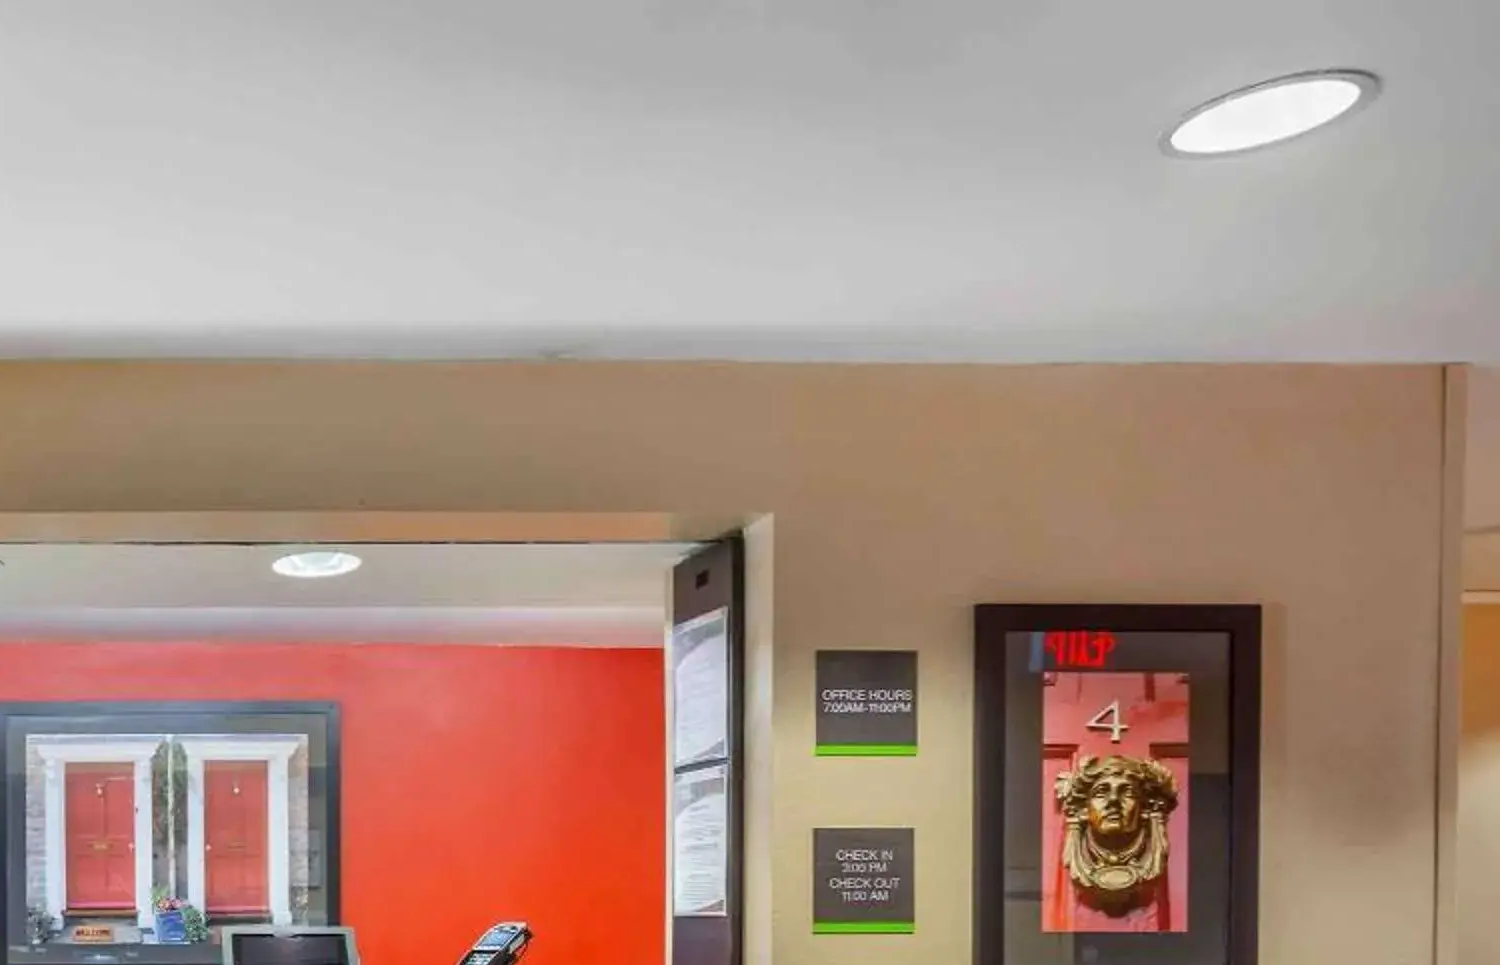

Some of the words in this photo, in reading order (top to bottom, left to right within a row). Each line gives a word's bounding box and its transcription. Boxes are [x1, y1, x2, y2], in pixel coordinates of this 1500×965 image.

[821, 689, 866, 701] OFFICE
[868, 689, 913, 701] HOURS
[1085, 700, 1130, 741] 4
[835, 849, 878, 860] CHECK
[881, 850, 894, 860] IN
[869, 862, 887, 873] PM
[829, 877, 872, 889] CHECK
[873, 877, 901, 889] OUT
[869, 890, 889, 901] AM
